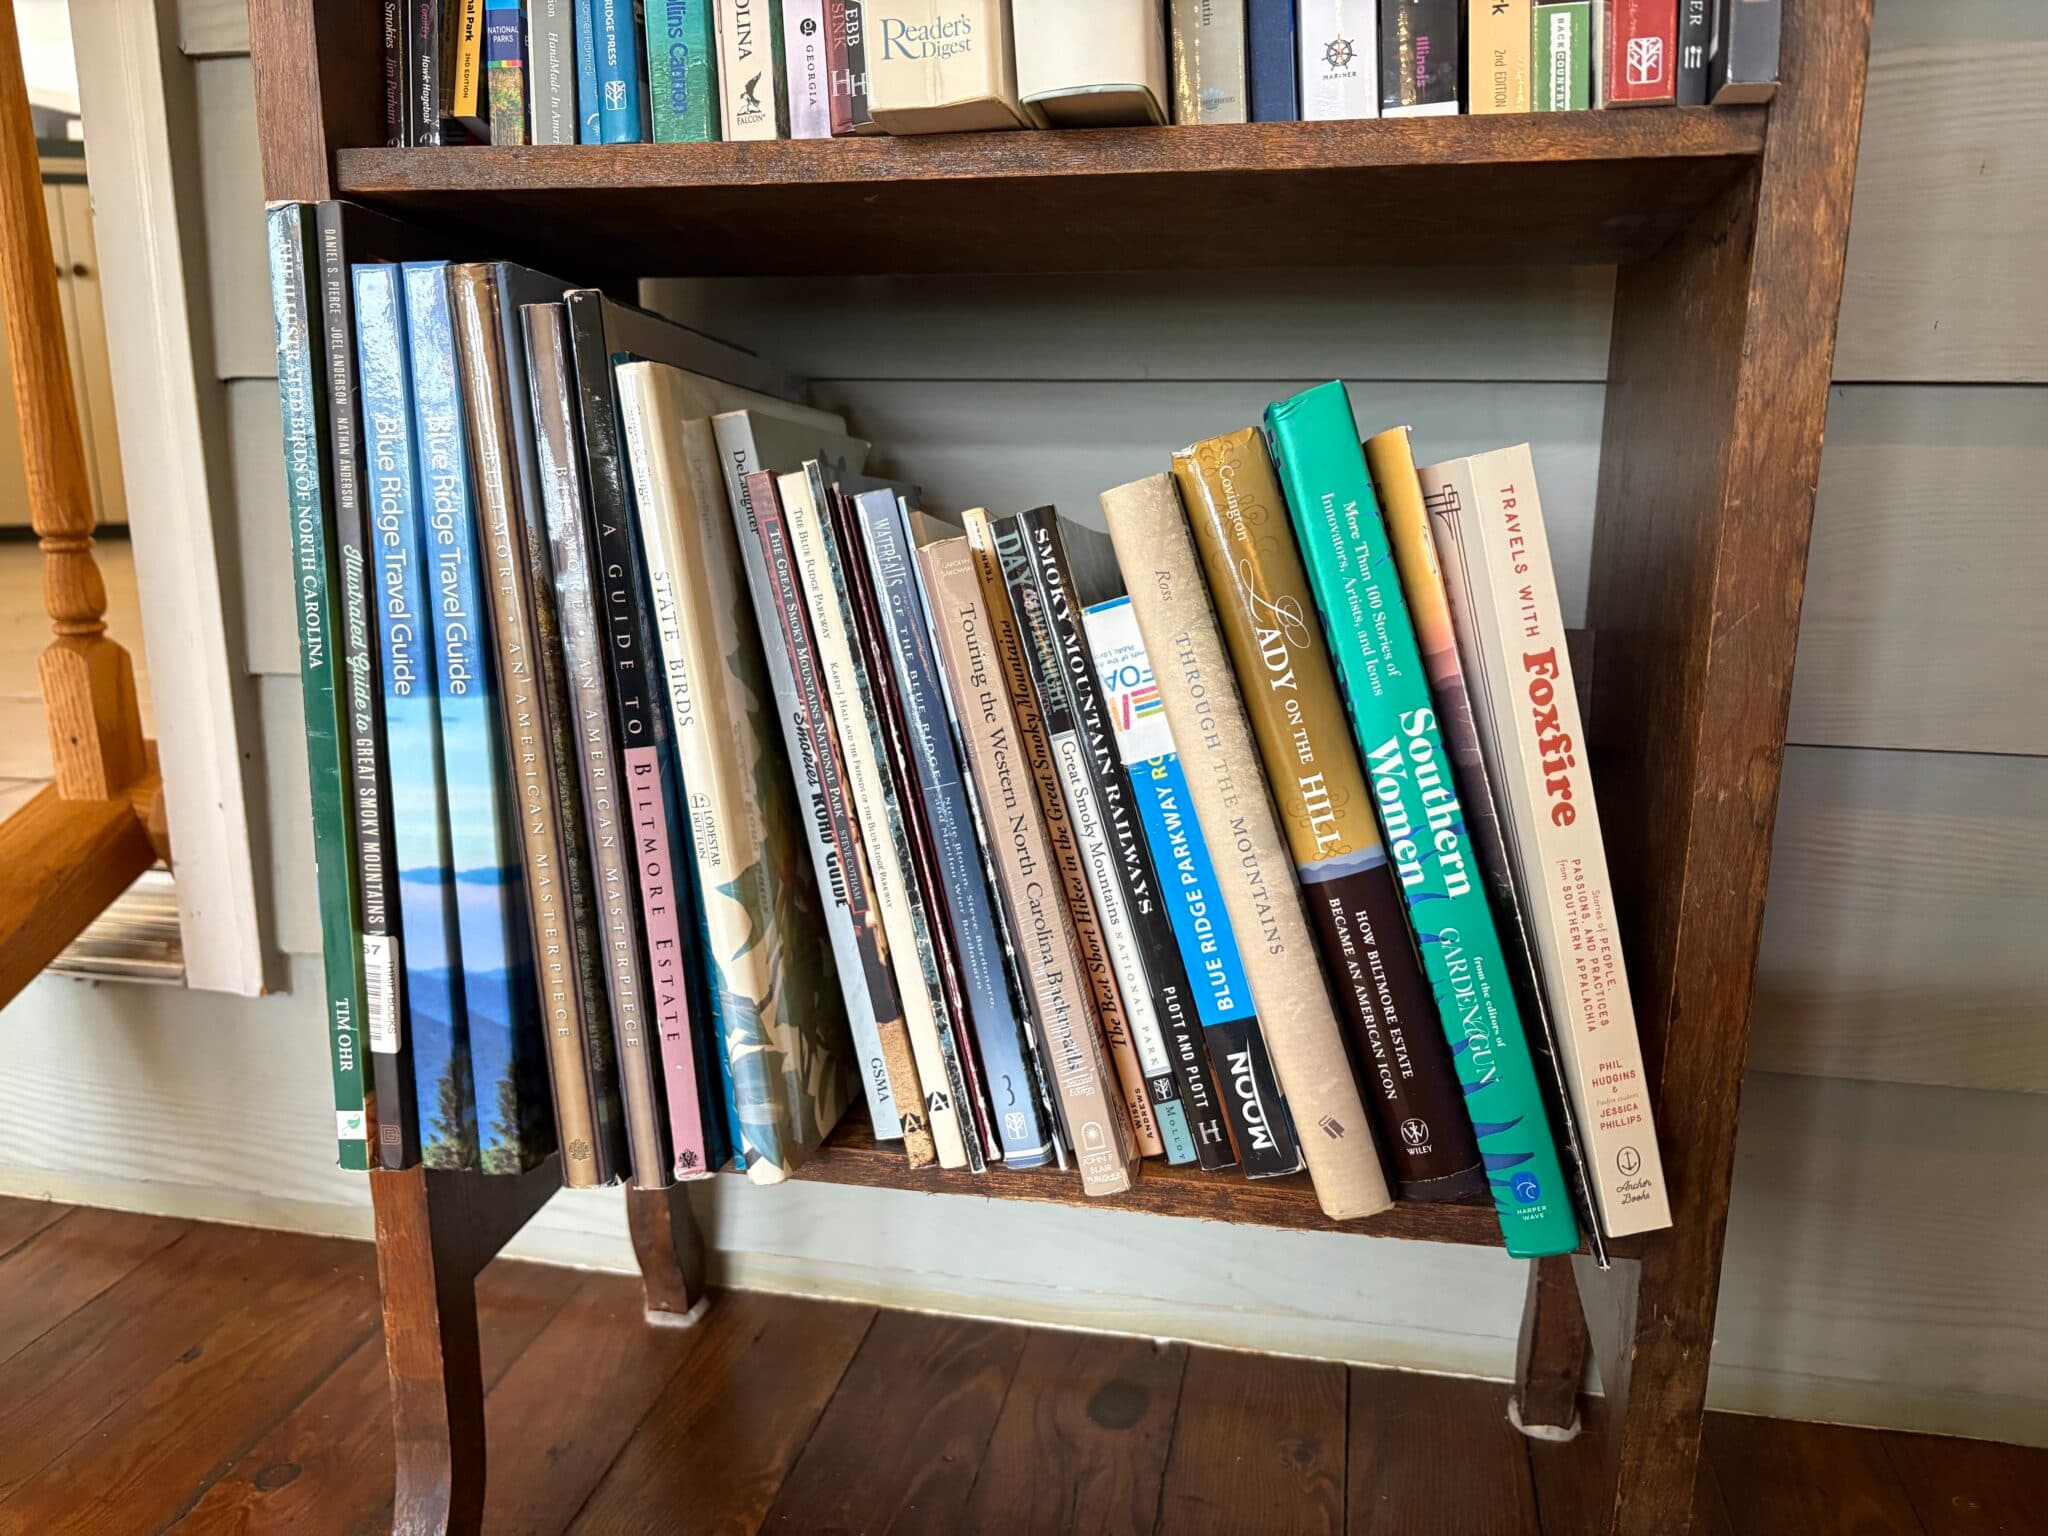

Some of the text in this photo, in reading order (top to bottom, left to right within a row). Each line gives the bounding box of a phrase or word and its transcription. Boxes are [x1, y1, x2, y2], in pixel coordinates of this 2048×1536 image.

[384, 2, 396, 49] Smokies
[465, 15, 475, 42] Park
[487, 25, 519, 44] NATIONAL PARKS
[604, 0, 617, 66] RIDGE PRESS
[880, 13, 971, 60] Reader's
[921, 38, 971, 60] Digest
[1415, 36, 1430, 88] Illinois
[420, 83, 432, 124] Hagebak
[549, 32, 560, 108] HandMade In
[669, 43, 689, 115] Cannon
[805, 44, 818, 107] GEORGIA
[1322, 71, 1357, 81] MARINER
[1495, 50, 1507, 108] 2nd EDITION
[736, 114, 763, 125] FALCON
[324, 229, 353, 508] DANIEL PIERCE JOEL ANDERSON NATHAN ANDERSON
[1219, 465, 1249, 542] Covington
[291, 416, 323, 669] BIRDS OF NORTH CAROLINA
[375, 412, 416, 696] Blue Ridge Travel Guide
[426, 415, 472, 695] Blue Ridge Travel Guide
[344, 544, 364, 650] Illustrated
[1154, 570, 1173, 601] Ross
[1321, 491, 1384, 698] Innovators, Artists, and Icons
[1343, 500, 1402, 677] More Than 100 Stories of
[346, 652, 371, 713] Guide
[653, 568, 694, 727] STATE BIRDS
[1500, 484, 1576, 828] TRAVELS WITH Foxfire
[769, 529, 851, 856] THE GREAT SMOKY MOUNTAINS NATIONAL PARK STEVE
[893, 595, 941, 778] OF THE BLUE RIDGE
[1034, 527, 1155, 915] SMOKY MOUNTAIN RAILWAYS
[357, 739, 374, 783] GREAT
[556, 466, 639, 1048] BILTMORE AN AMERICAN MASTERPIECE
[602, 523, 681, 1042] A GUIDE TO BILTMORE ESTATE
[959, 602, 988, 688] Touring
[980, 691, 998, 724] the
[990, 724, 1017, 810] Western
[1009, 813, 1037, 876] North
[1027, 881, 1053, 965] Carolina
[1176, 632, 1285, 956] THROUGH THE MOUNTAINS
[1284, 698, 1342, 855] ON THE HILL
[360, 787, 378, 837] SMOKY
[509, 643, 570, 1038] AN AMERICAN MASTERPIECE
[703, 810, 720, 866] LODESTAR
[1000, 620, 1127, 1049] The Short Hikes the Great Smoky Mountains
[1062, 740, 1120, 926] Great Smoky Mountains
[1367, 735, 1426, 888] Women
[1399, 707, 1471, 900] Southern
[363, 842, 384, 925] MOUNTAINS
[1155, 786, 1234, 1011] BLUE RIDGE PARKWAY
[1591, 889, 1603, 920] Stories
[1556, 859, 1597, 1033] from SOUTHERN APPALACHIA
[1571, 858, 1610, 1027] PASSIONS, AND PRACTICES
[1328, 897, 1398, 1101] BECAME AN AMERICAN ICON
[1355, 910, 1414, 1080] HOW BILTMORE ESTATE
[1473, 956, 1507, 1048] from the editors of
[335, 998, 354, 1072] TIM OHR
[1163, 986, 1209, 1108] PLOTT AND PLOTT
[1599, 1060, 1623, 1073] PHIL
[870, 1057, 890, 1104] GSMA
[1130, 1101, 1142, 1130] WISE
[1134, 1087, 1154, 1139] ANDREWS
[1227, 1051, 1274, 1150] MOON
[1591, 1070, 1637, 1088] HUDGINS
[1599, 1104, 1639, 1119] JESSICA
[1406, 1145, 1433, 1157] WILEY
[1599, 1115, 1642, 1131] PHILLIPS
[1516, 1205, 1547, 1216] HARPER
[1522, 1213, 1545, 1221] WAVE
[1616, 1177, 1652, 1193] Anchor
[1621, 1192, 1651, 1206] Books
